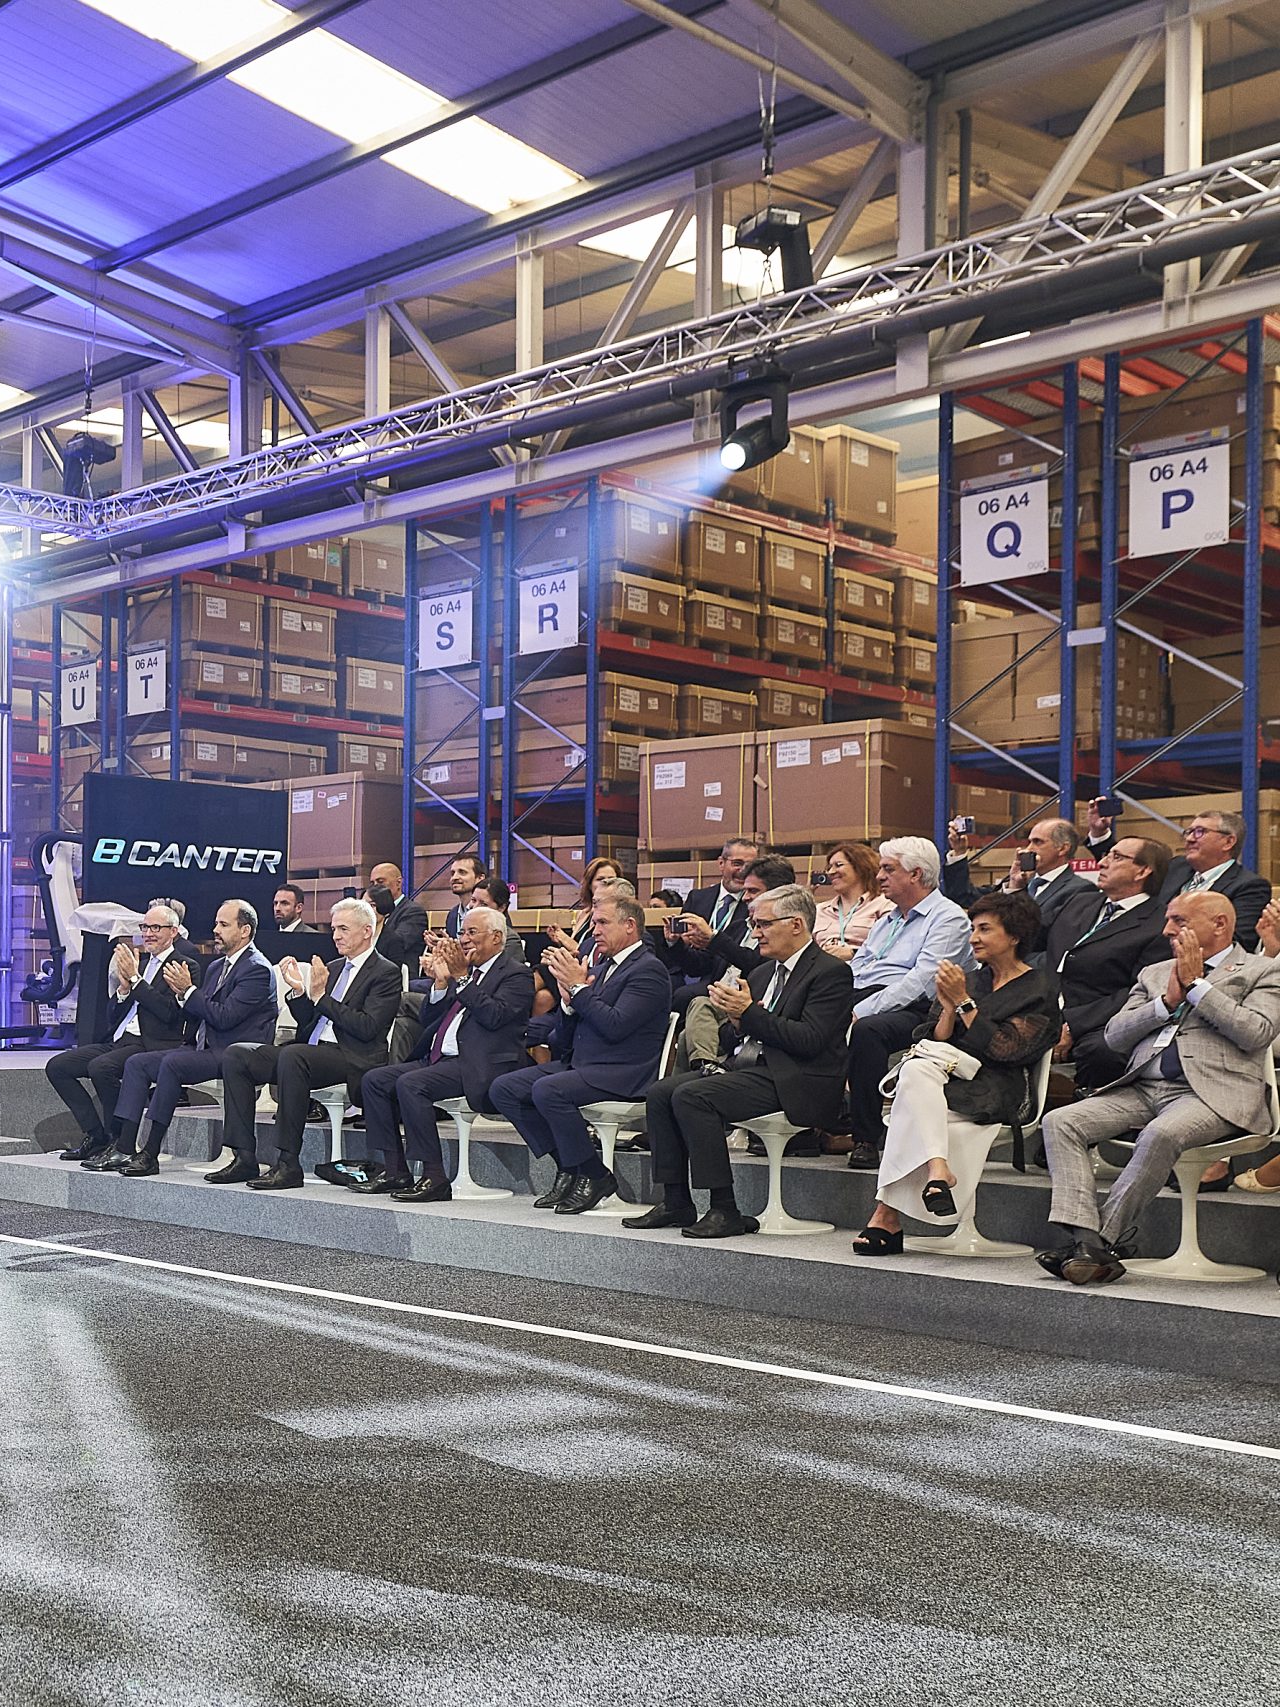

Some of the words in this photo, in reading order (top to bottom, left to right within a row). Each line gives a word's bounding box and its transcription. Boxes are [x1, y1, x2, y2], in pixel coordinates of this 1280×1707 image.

[1149, 463, 1173, 482] 06
[1179, 456, 1209, 478] A4
[978, 497, 1000, 516] 06
[1005, 491, 1030, 511] A4
[1161, 488, 1195, 530] P
[986, 520, 1022, 559] Q
[531, 583, 546, 597] 06
[549, 579, 566, 594] A4
[429, 602, 444, 616] 06
[446, 600, 461, 614] A4
[538, 602, 559, 634] R
[436, 621, 455, 651] S
[135, 658, 146, 670] 06
[146, 656, 158, 669] A4
[68, 671, 78, 683] 06
[79, 669, 90, 681] A4
[140, 674, 153, 699] T
[72, 686, 85, 711] U
[1071, 860, 1096, 871] TEN
